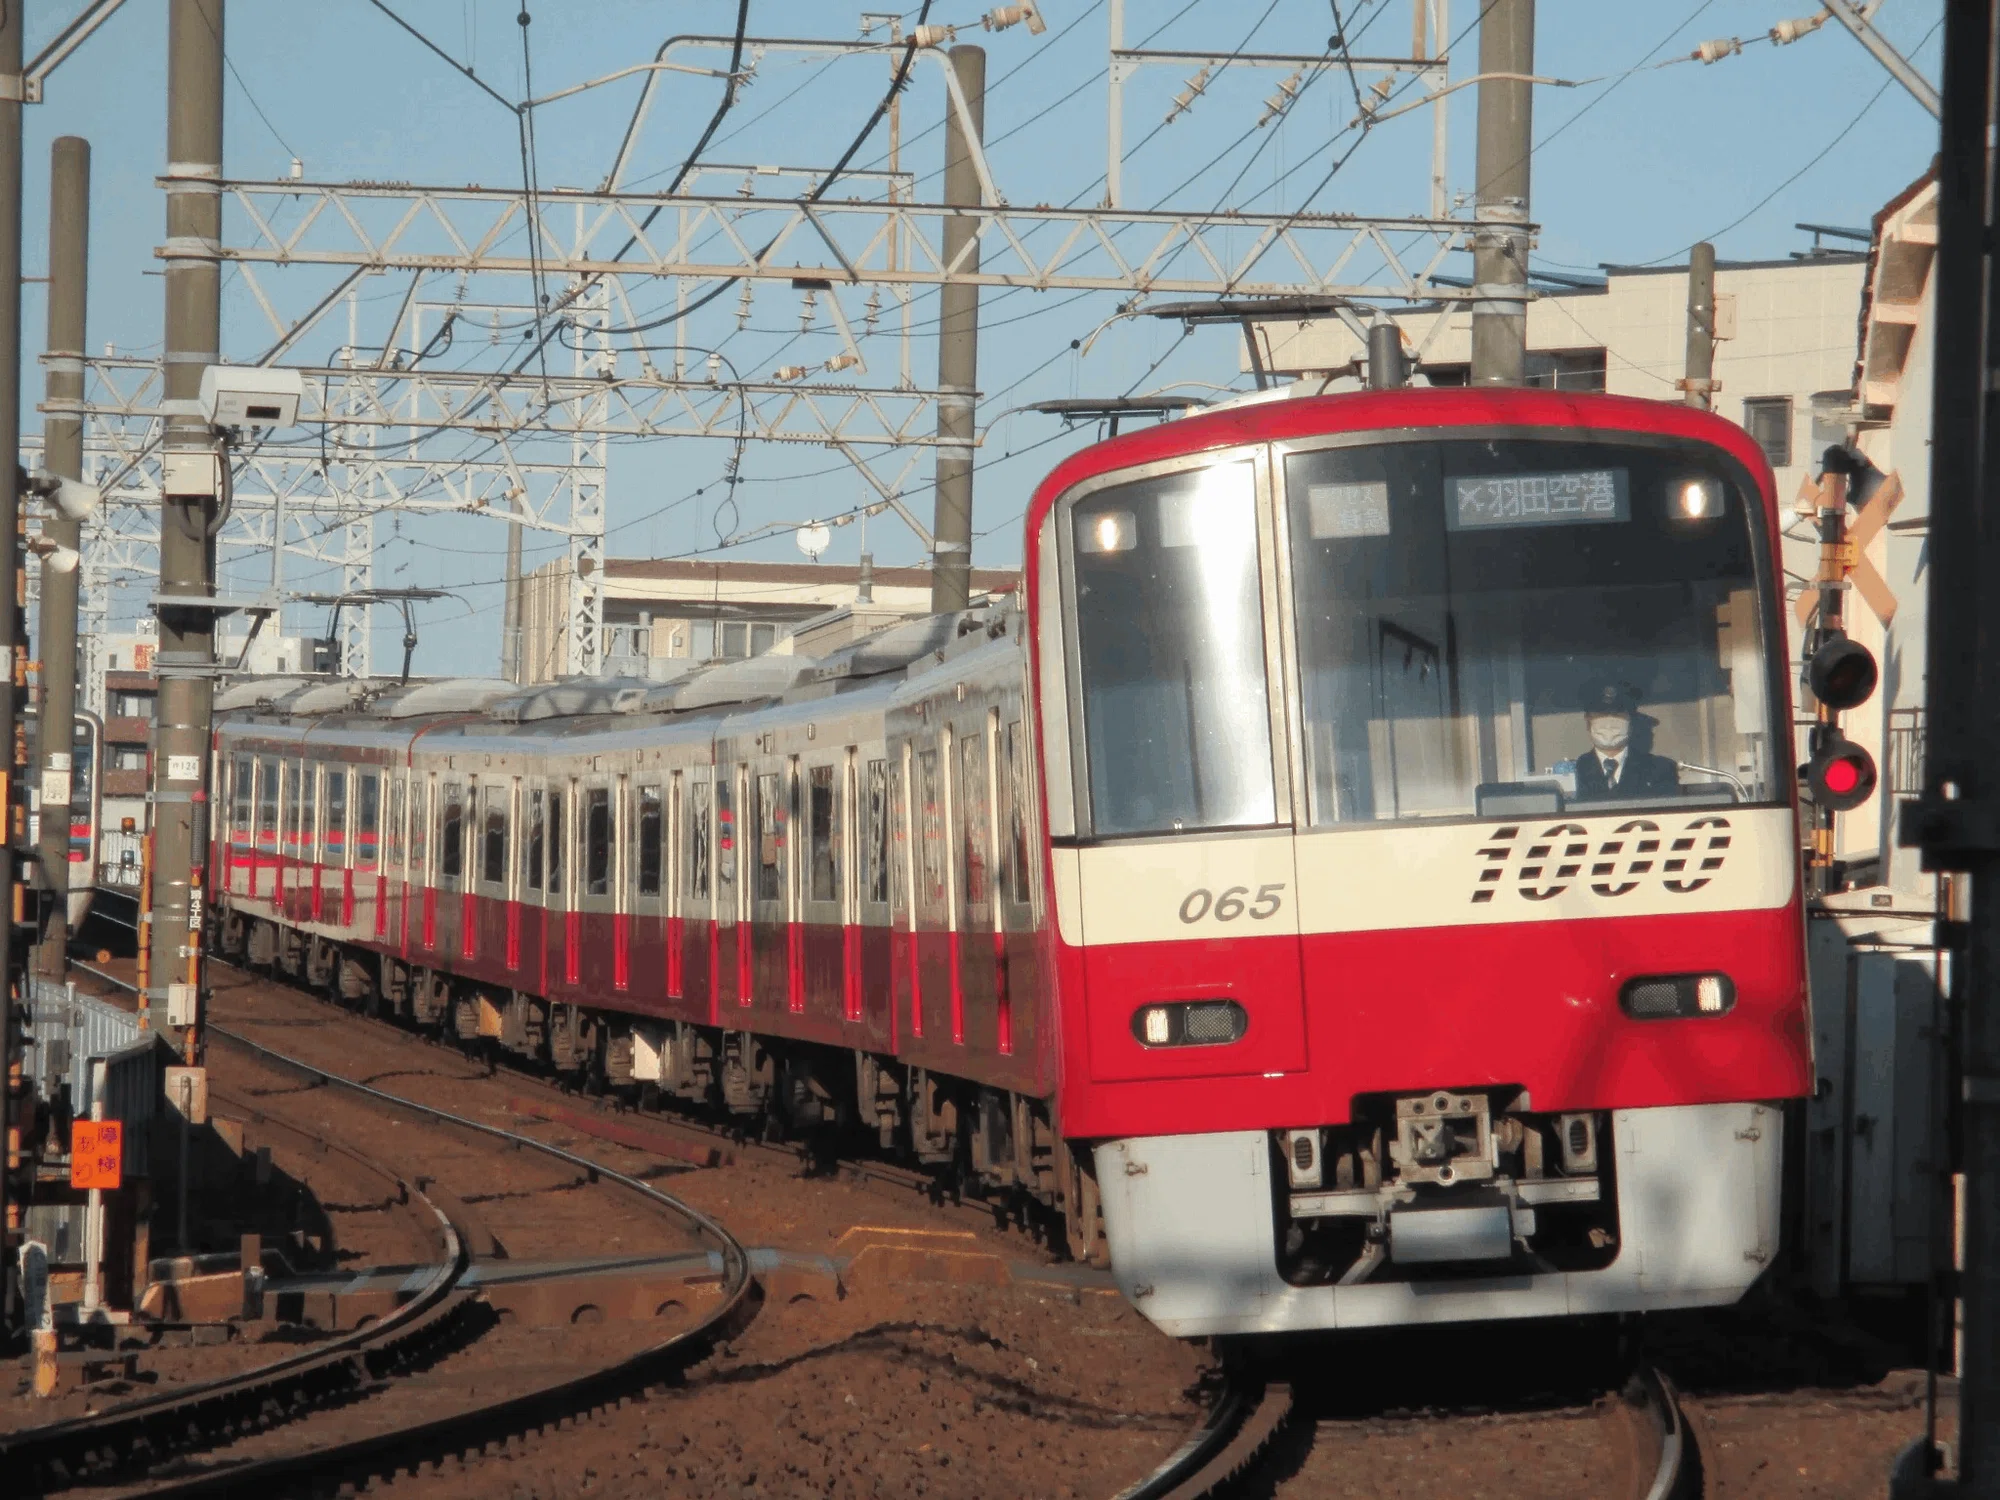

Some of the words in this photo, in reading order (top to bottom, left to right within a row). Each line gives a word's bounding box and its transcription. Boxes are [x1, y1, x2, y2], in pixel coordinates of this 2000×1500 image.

[1488, 471, 1615, 517] 羽田空港
[1471, 816, 1731, 903] 1000
[1178, 883, 1286, 924] 065
